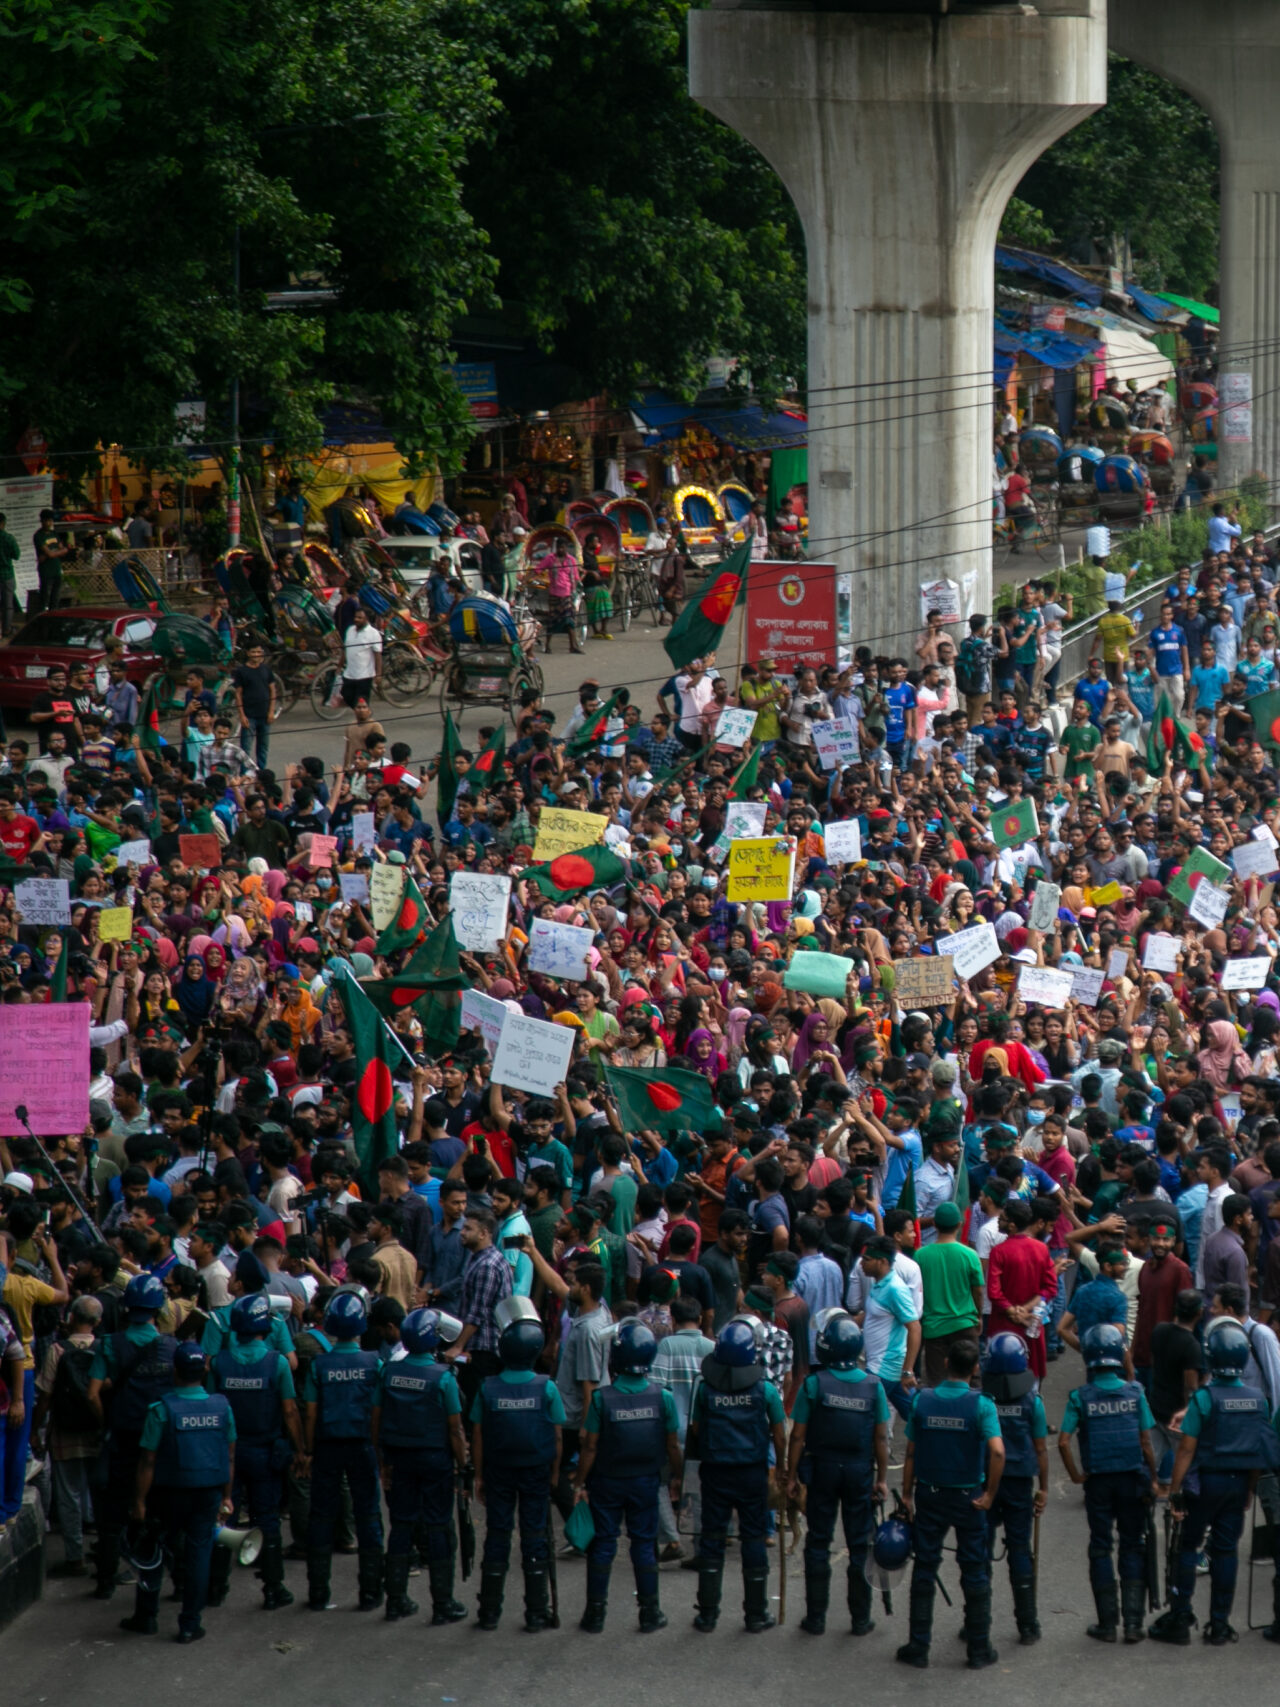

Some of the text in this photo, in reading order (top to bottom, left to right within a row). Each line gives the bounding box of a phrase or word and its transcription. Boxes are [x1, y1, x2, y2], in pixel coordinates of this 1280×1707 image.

[755, 618, 829, 631] হাসপাতাল এলাকায়
[784, 634, 814, 646] বাজানো
[797, 651, 826, 662] অপরাধ
[328, 1369, 365, 1380] POLICE
[228, 1379, 260, 1389] POLICE
[393, 1376, 424, 1389] POLICE
[500, 1399, 533, 1409] POLICE
[715, 1396, 752, 1406] POLICE
[1225, 1399, 1255, 1409] POLICE
[1088, 1400, 1137, 1416] POLICE
[619, 1409, 651, 1419] POLICE
[182, 1416, 219, 1427] POLICE
[930, 1418, 962, 1428] POLICE
